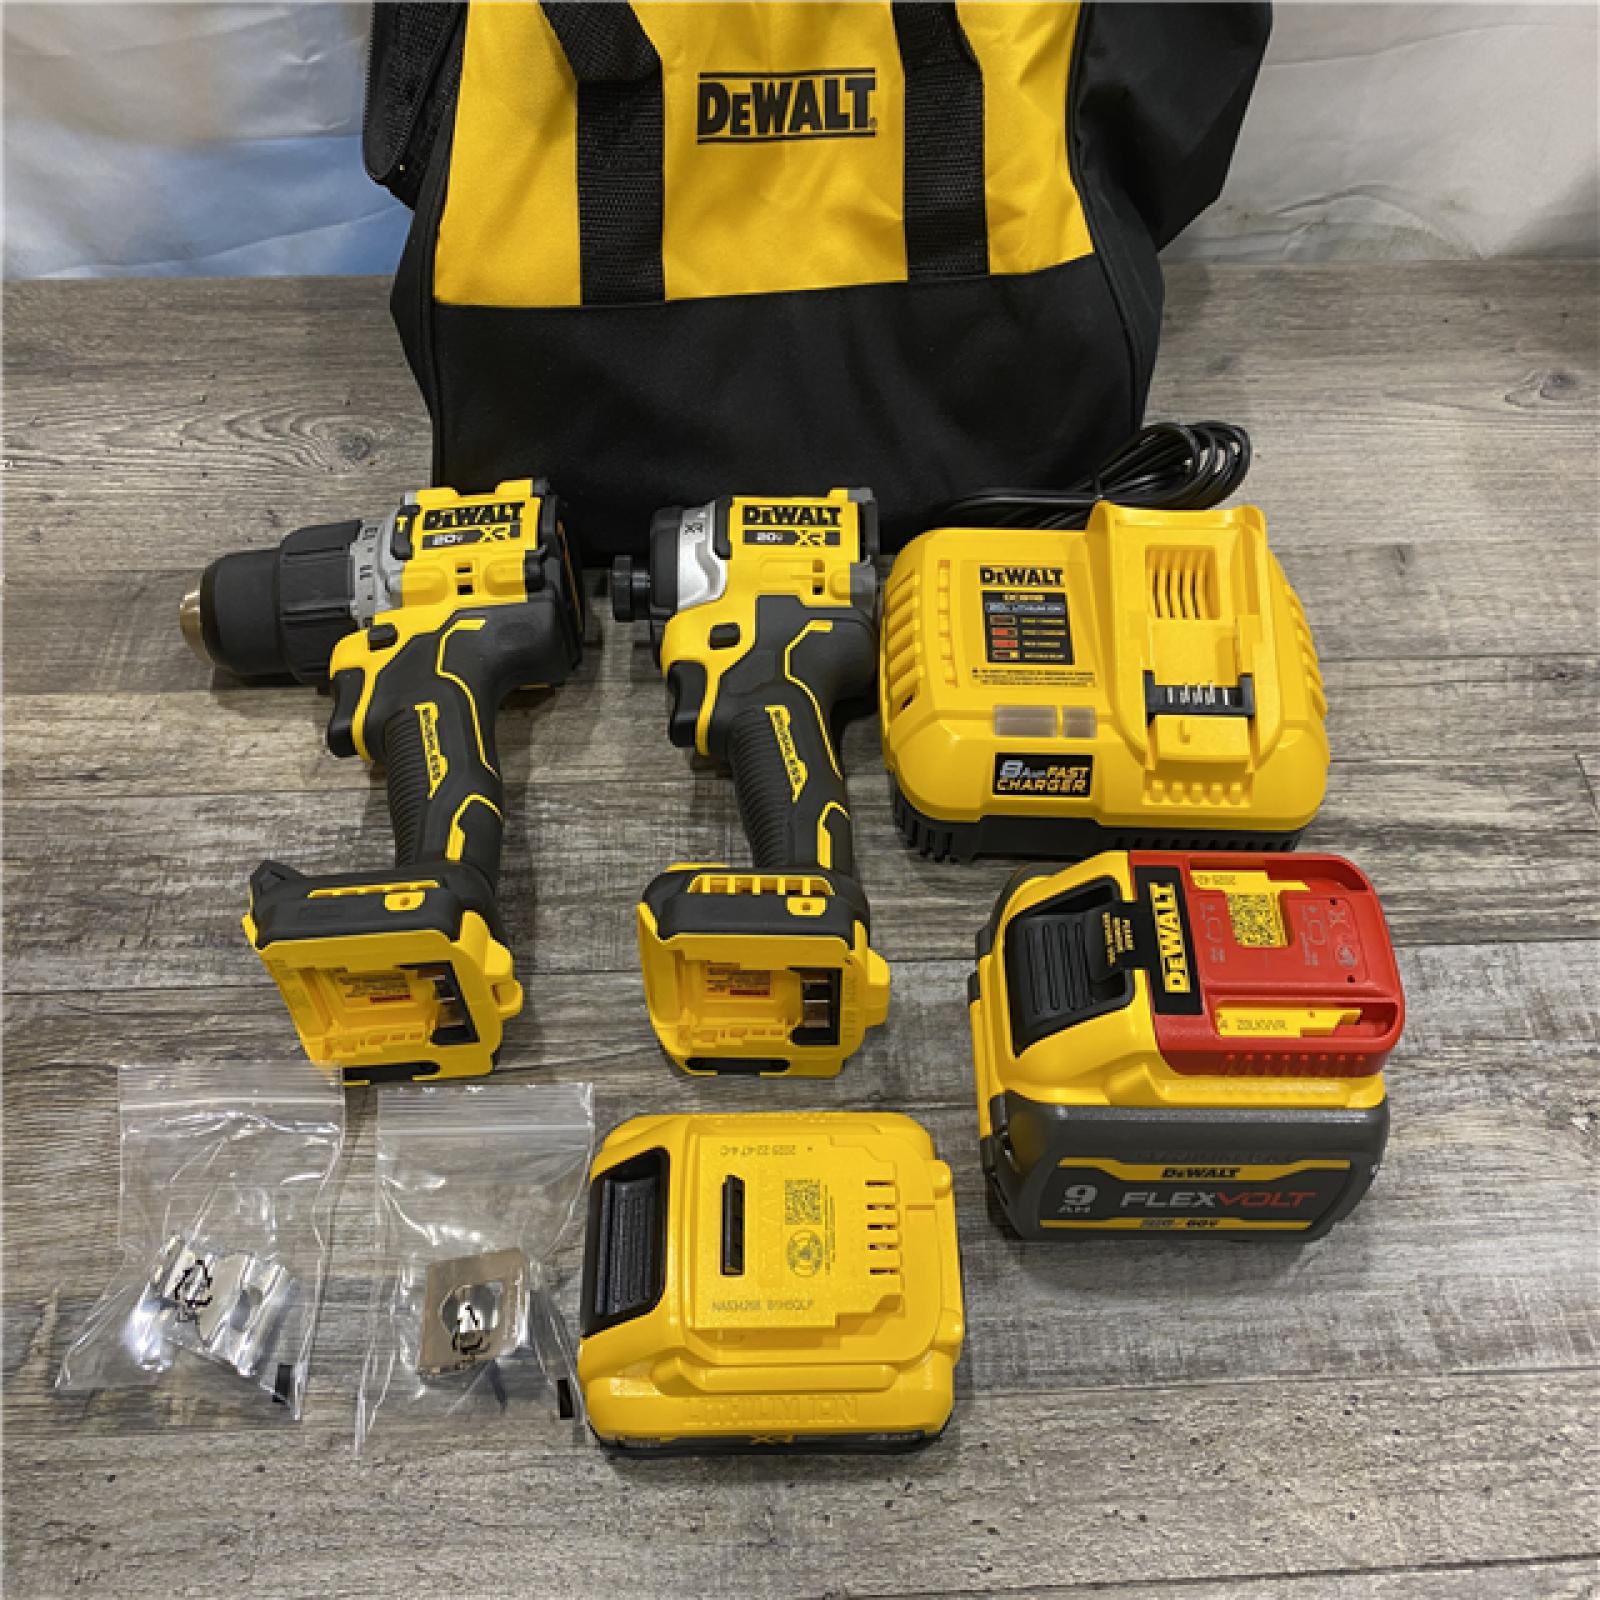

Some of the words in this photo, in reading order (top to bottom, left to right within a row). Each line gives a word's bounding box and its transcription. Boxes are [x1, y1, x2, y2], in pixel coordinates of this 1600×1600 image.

[697, 77, 876, 136] DEWALT
[980, 567, 1064, 585] DEWALT
[997, 779, 1087, 792] CHARGER
[1150, 882, 1191, 993] DEWALT
[1064, 1184, 1098, 1205] 9
[1119, 1191, 1316, 1208] FLEXVOLT
